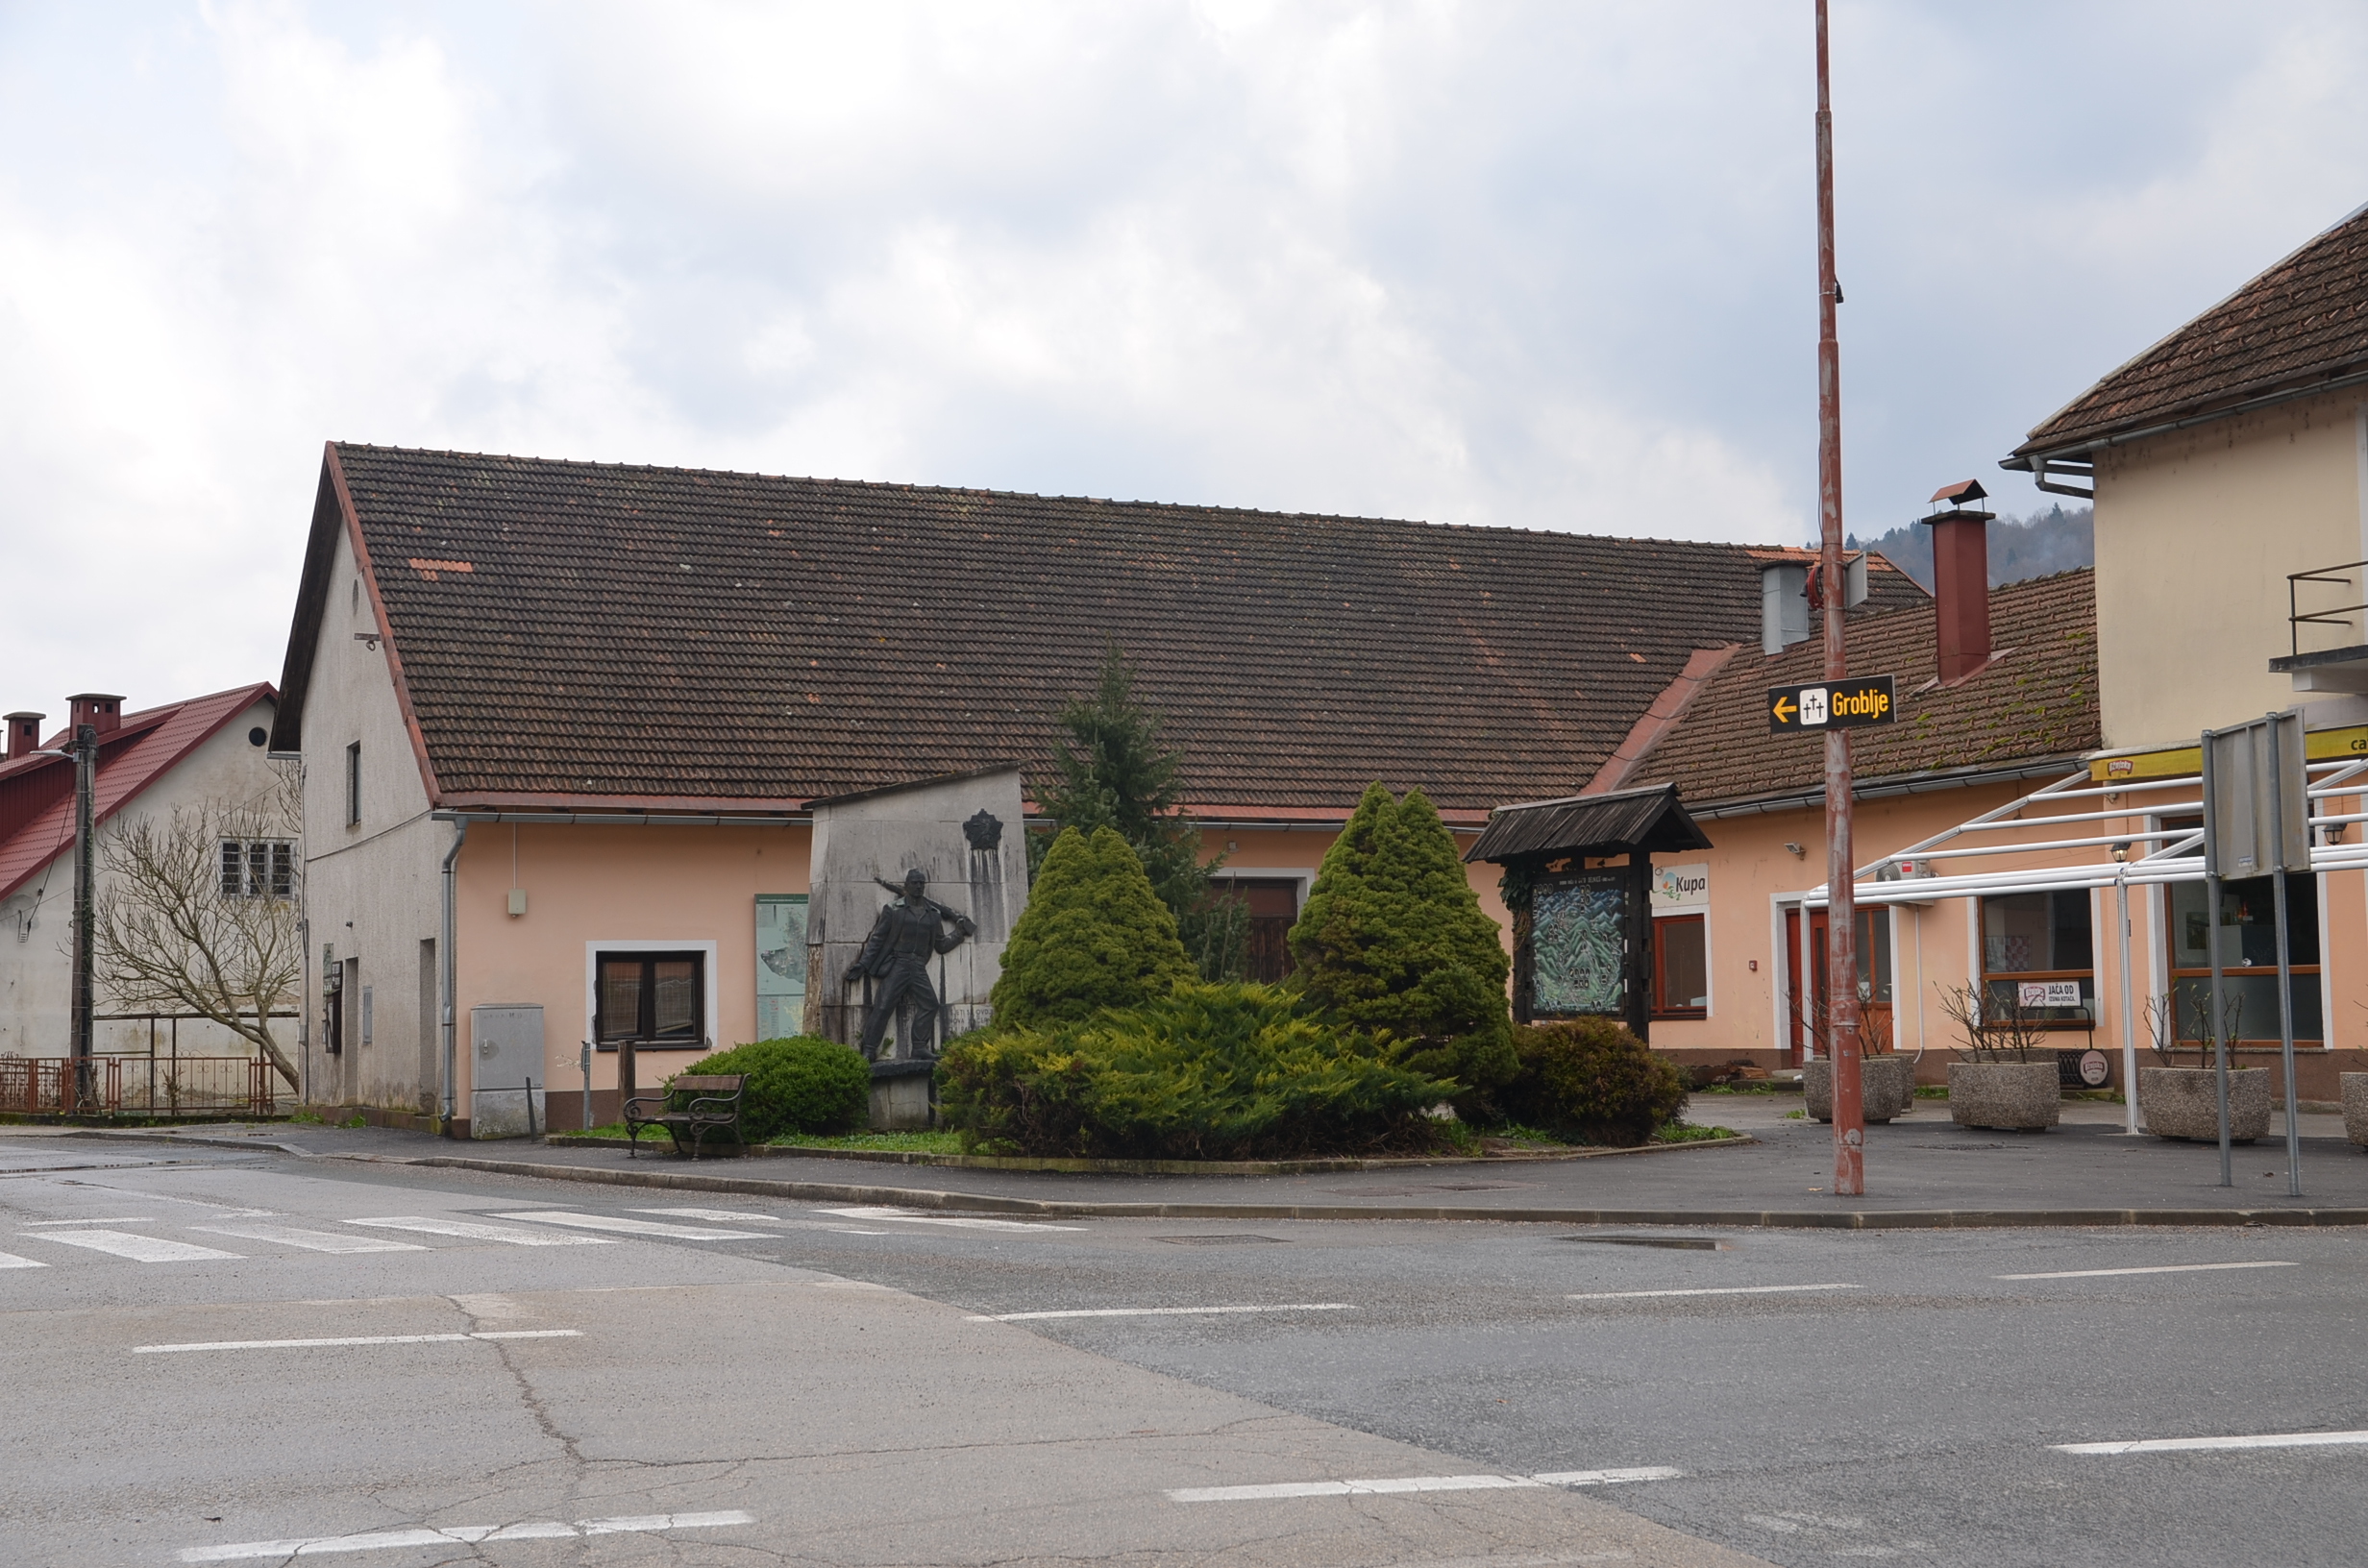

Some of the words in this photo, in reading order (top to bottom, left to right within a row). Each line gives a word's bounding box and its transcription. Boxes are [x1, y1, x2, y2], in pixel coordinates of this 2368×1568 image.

[1832, 689, 1888, 719] Groblje
[2351, 739, 2368, 751] ca
[1676, 876, 1706, 895] Kupa
[2049, 983, 2063, 994] JAČA
[2064, 985, 2074, 994] OD
